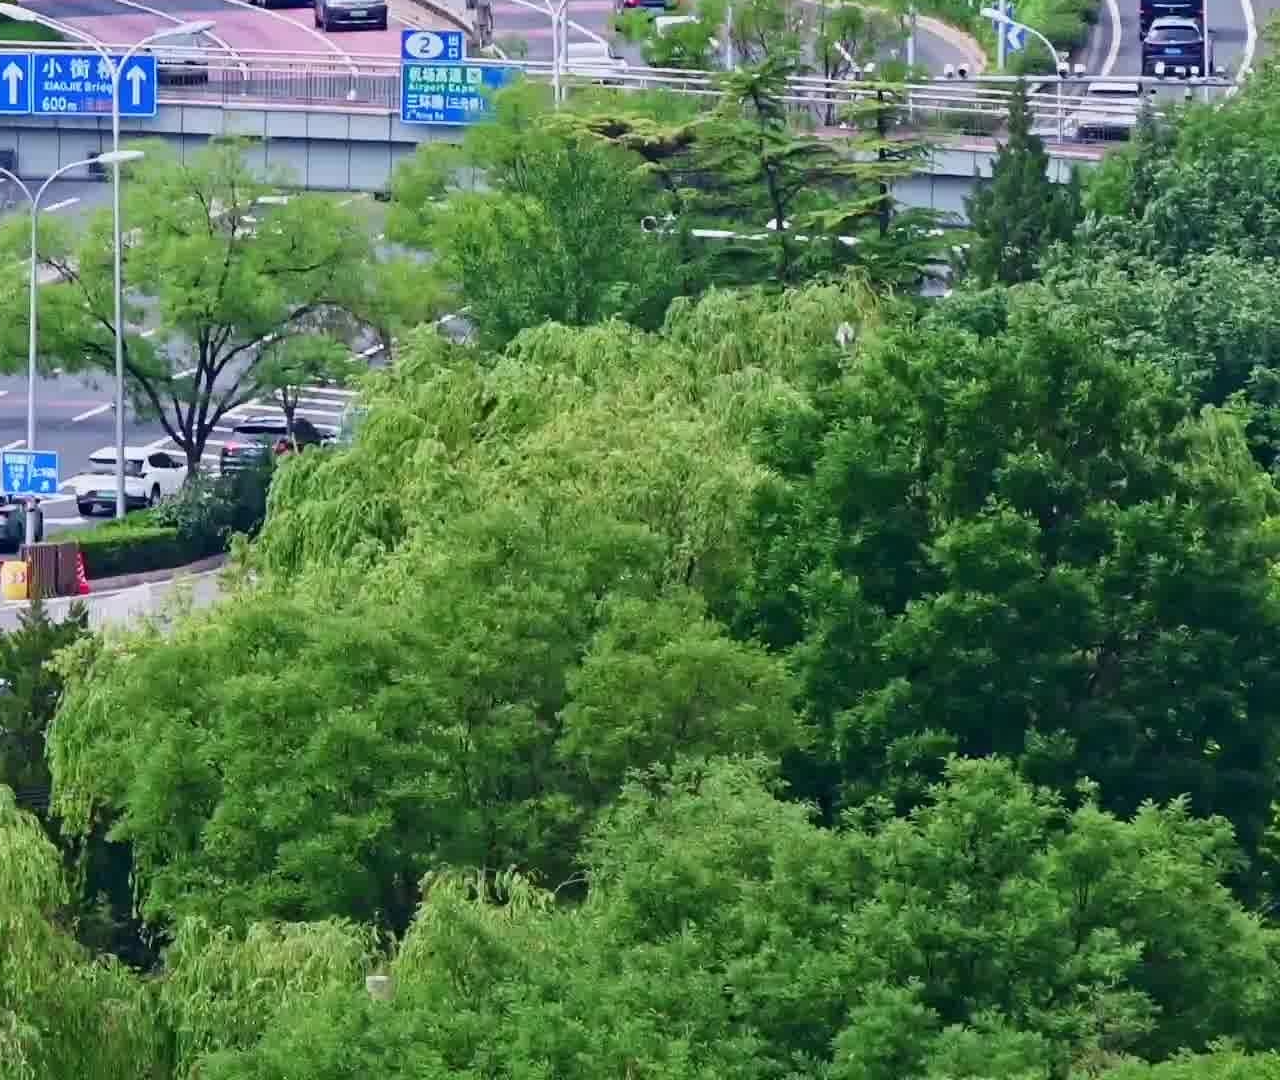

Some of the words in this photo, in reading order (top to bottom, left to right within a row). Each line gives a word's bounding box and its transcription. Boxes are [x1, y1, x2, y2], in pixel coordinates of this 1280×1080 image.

[419, 36, 431, 54] 2
[448, 34, 459, 58] 出口
[43, 81, 82, 92] XIAOJIE
[42, 96, 79, 112] 600m
